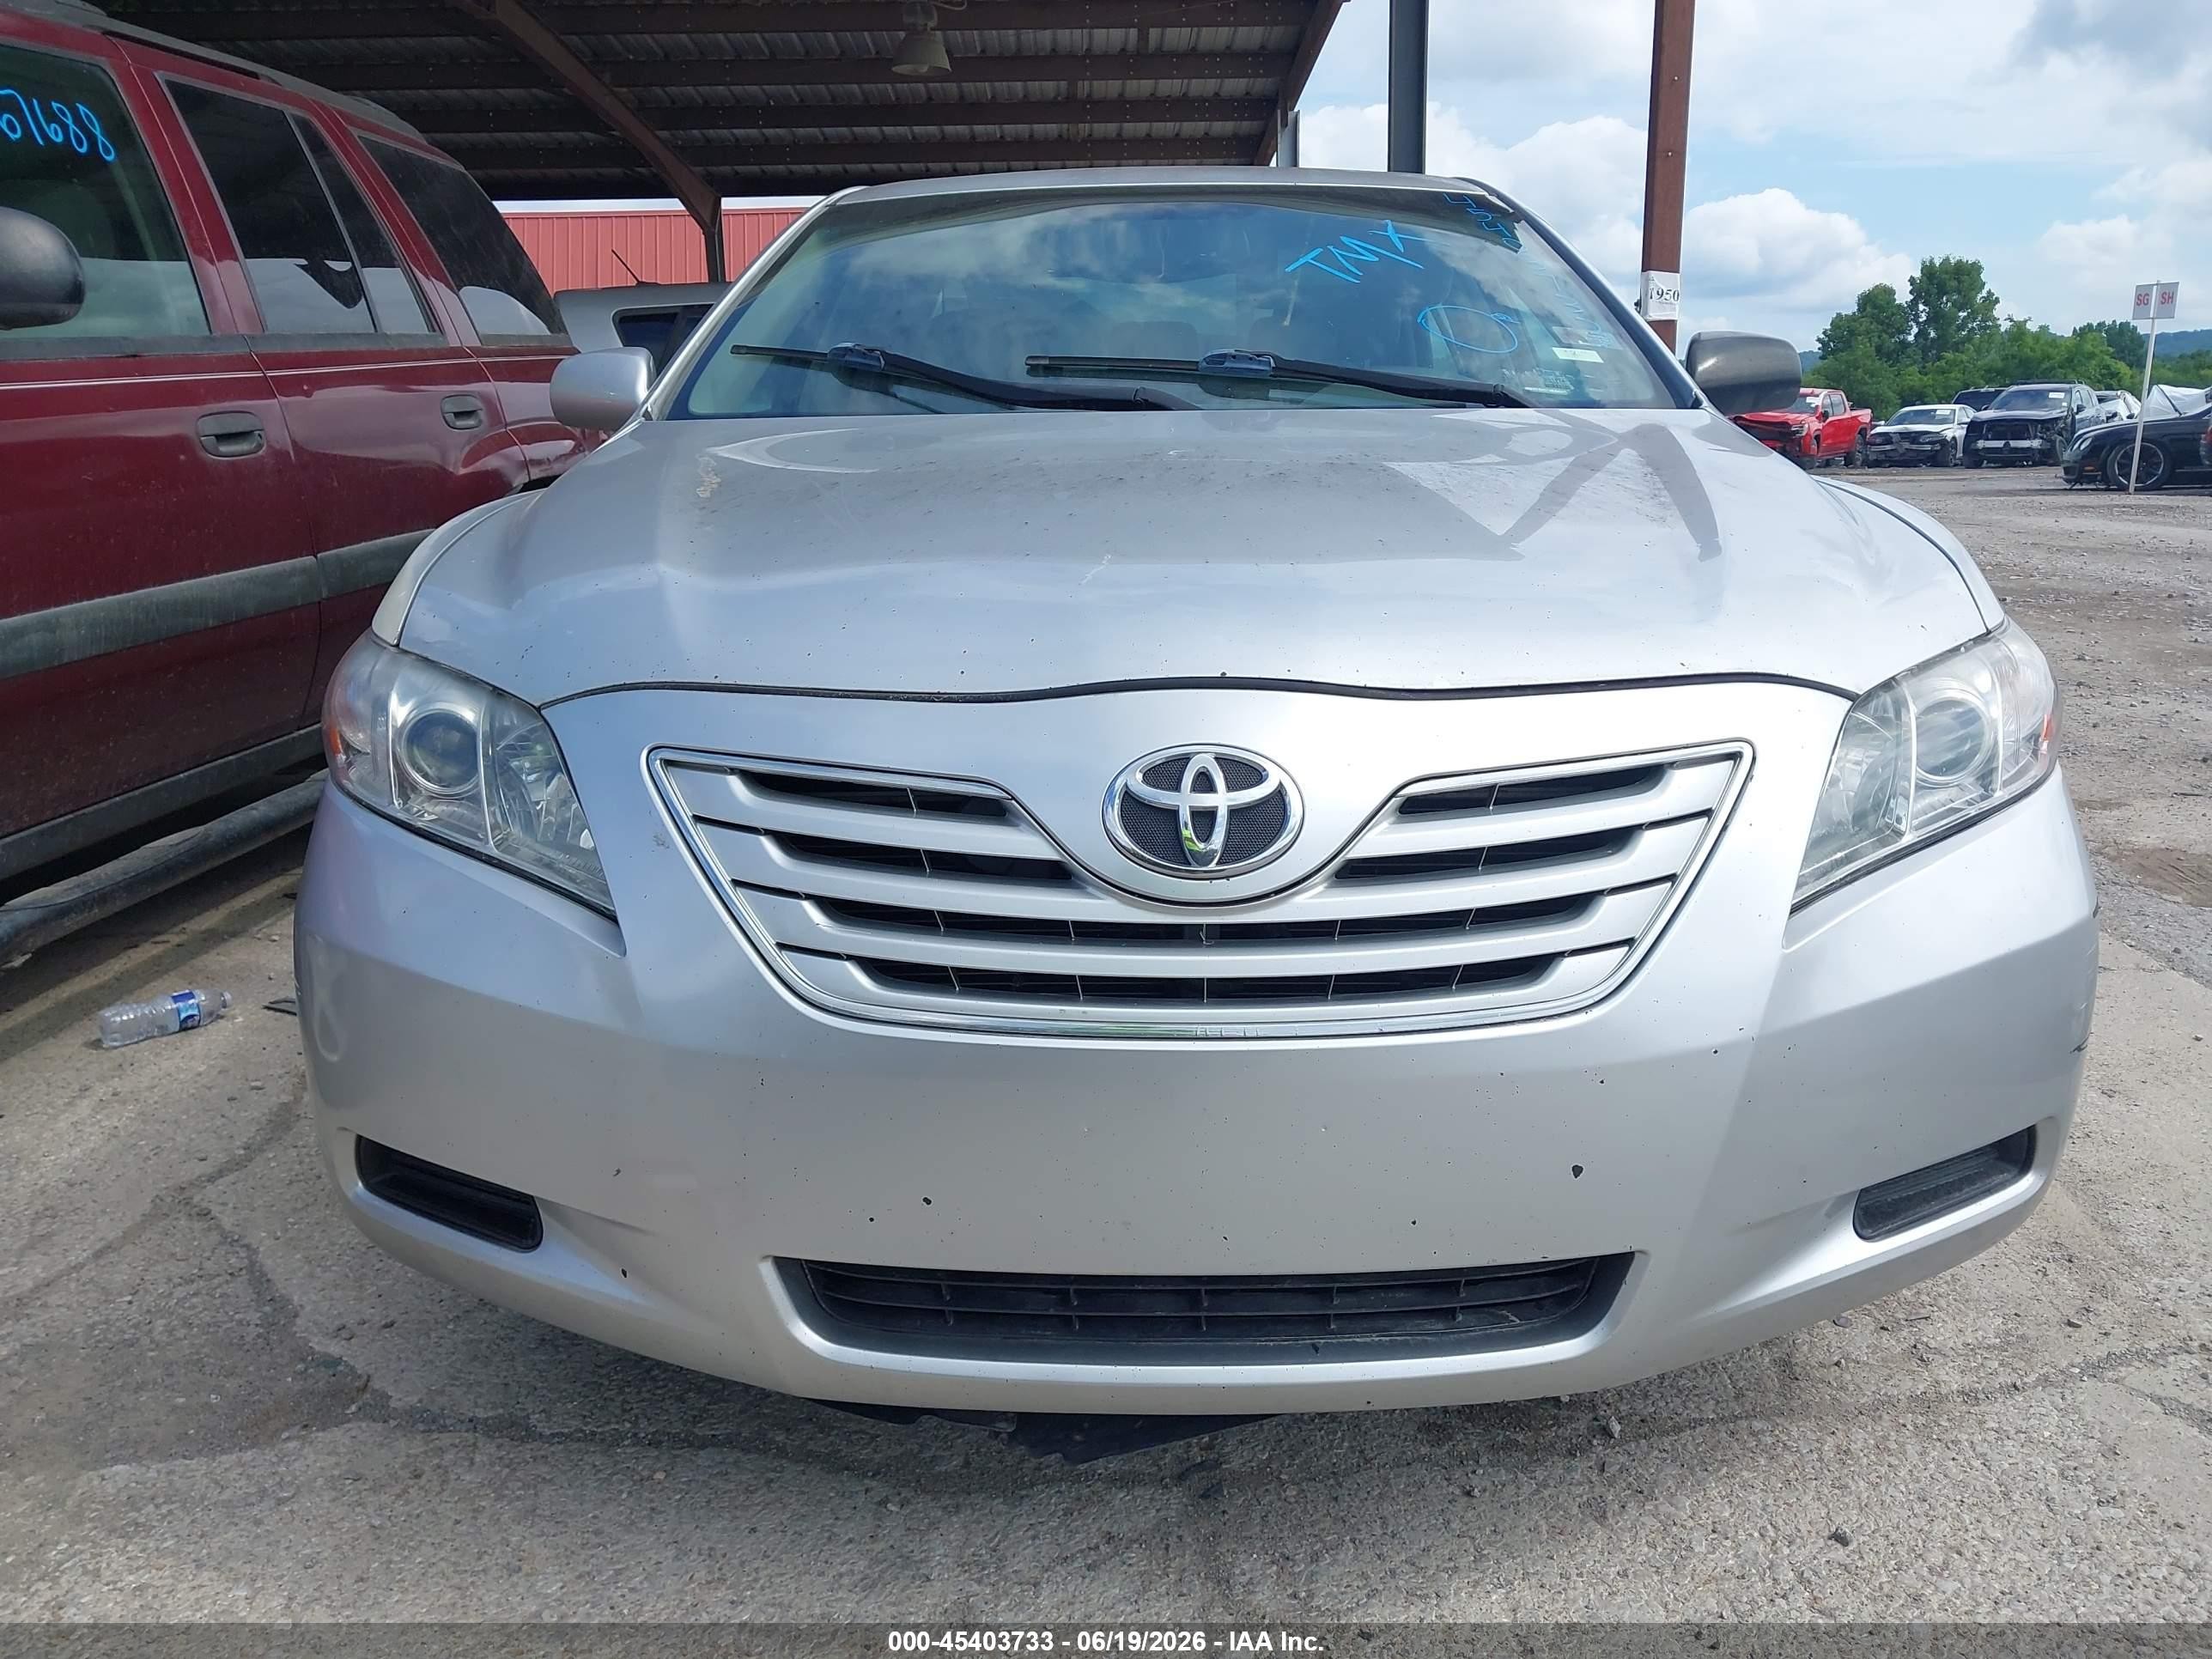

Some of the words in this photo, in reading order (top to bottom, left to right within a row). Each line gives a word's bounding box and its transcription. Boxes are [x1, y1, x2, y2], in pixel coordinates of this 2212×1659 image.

[1284, 219, 1430, 283] TMX
[2136, 292, 2150, 307] SG
[2160, 290, 2174, 305] SH
